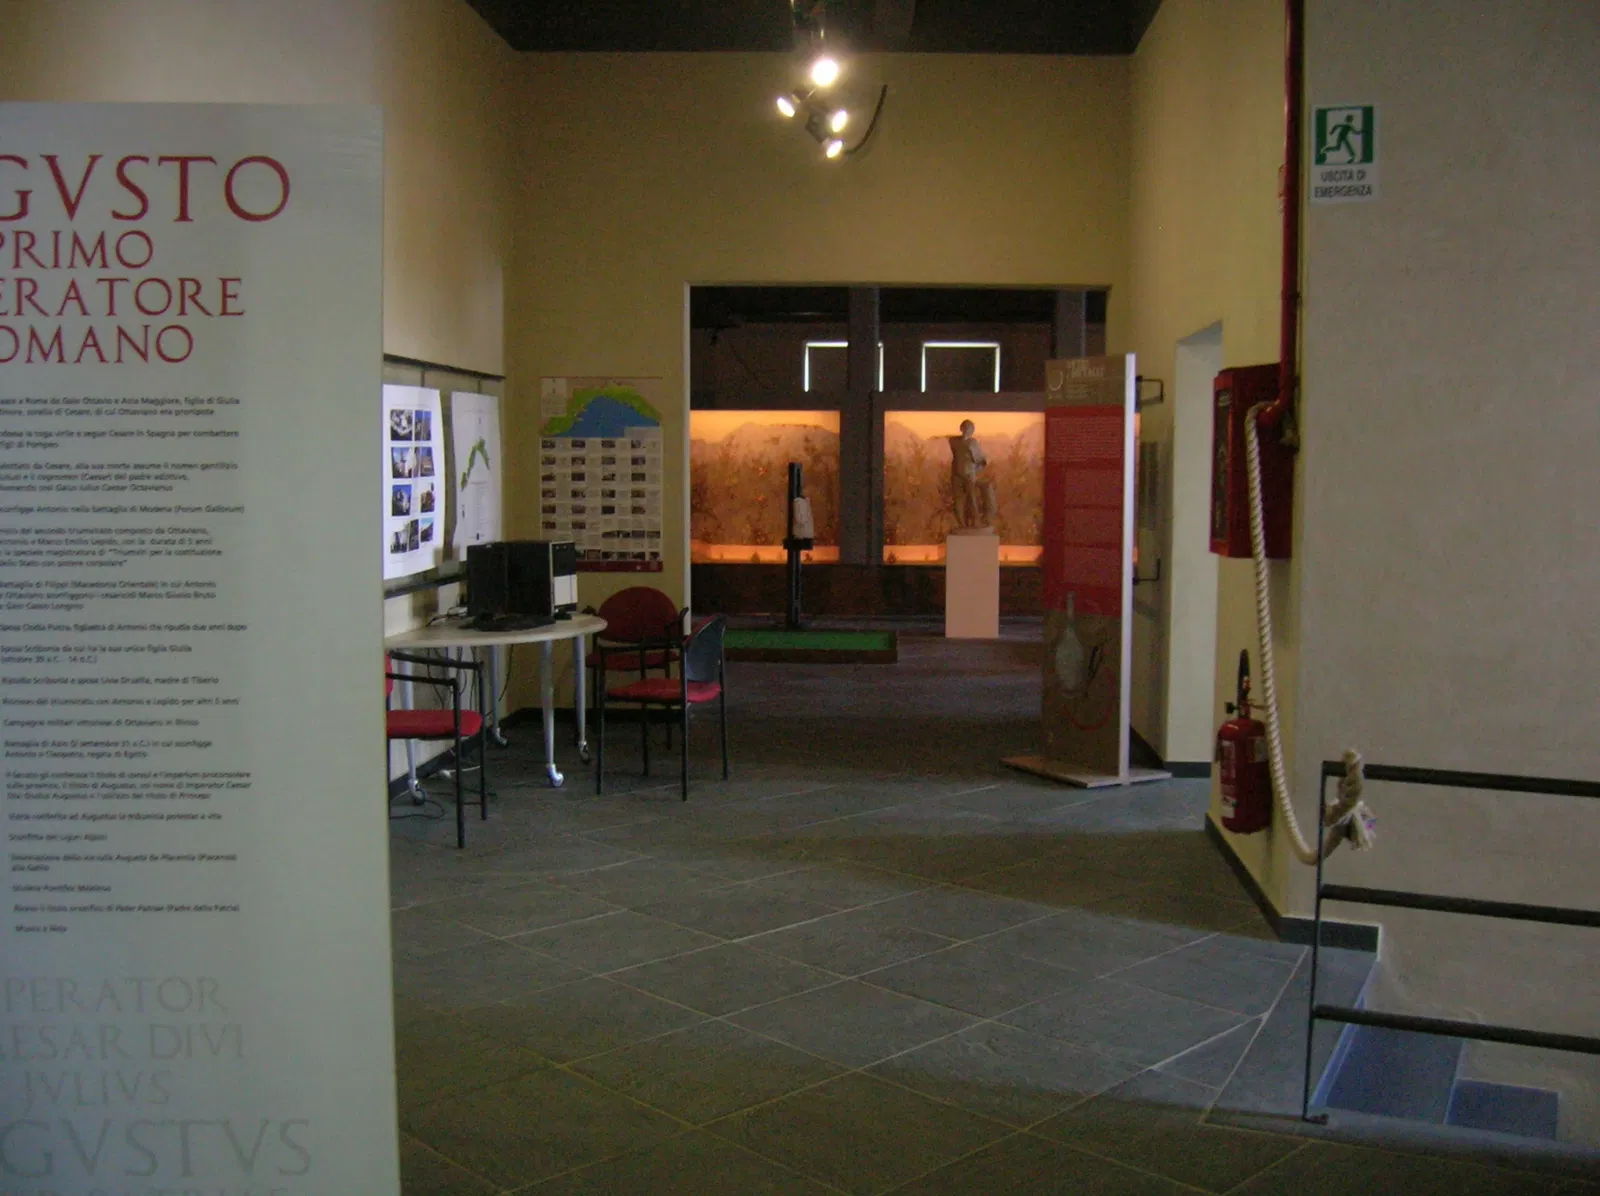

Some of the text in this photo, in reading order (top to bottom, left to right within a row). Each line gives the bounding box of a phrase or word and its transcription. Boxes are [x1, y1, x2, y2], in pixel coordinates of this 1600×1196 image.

[1321, 168, 1366, 182] USCITA DI
[1314, 184, 1372, 198] EMERGENZA
[0, 230, 154, 269] RIMO
[0, 277, 246, 317] RATORE
